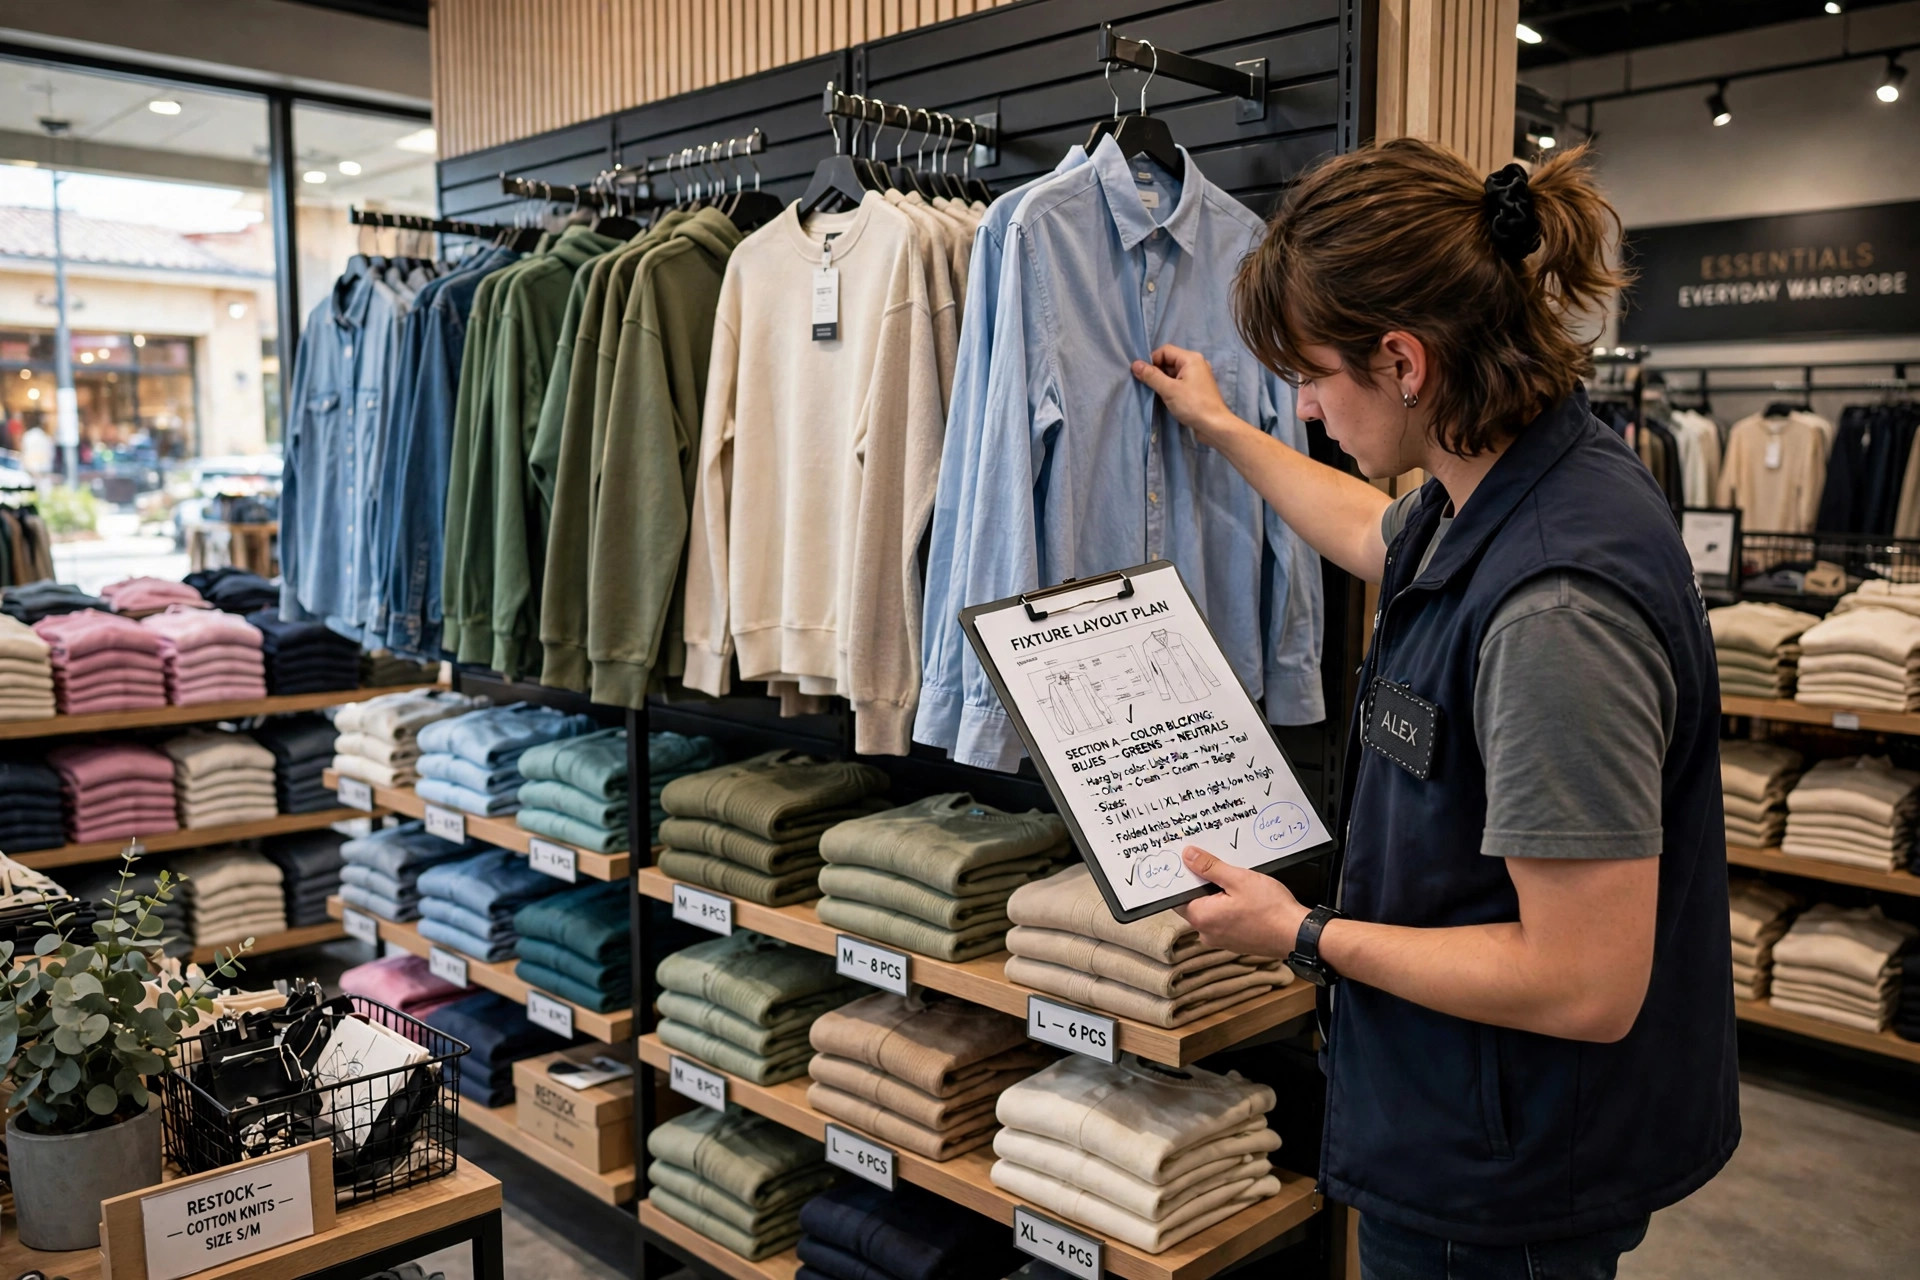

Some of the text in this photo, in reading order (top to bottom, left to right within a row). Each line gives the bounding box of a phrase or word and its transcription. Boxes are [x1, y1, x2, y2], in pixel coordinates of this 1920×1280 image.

[1701, 242, 1875, 280] ESSENTIALS
[1678, 271, 1908, 308] EVERYDAY WARDROBE
[1010, 600, 1170, 651] FIXTURE LAYOUT PLAN
[1065, 740, 1110, 760] SECTION
[1112, 738, 1121, 748] A
[1130, 724, 1166, 741] COLOR
[1121, 739, 1163, 758] GREENS
[1177, 720, 1229, 743] NEUTRALS
[1381, 710, 1418, 747] ALEX
[1110, 770, 1122, 781] by
[1229, 732, 1249, 744] Teal
[1105, 815, 1114, 826] S
[1121, 809, 1132, 821] M
[1195, 788, 1206, 797] to
[1244, 773, 1255, 782] to
[1115, 825, 1149, 844] Folded
[1200, 808, 1213, 817] on
[1122, 842, 1149, 859] group
[1149, 837, 1162, 849] by
[678, 894, 688, 911] M
[709, 905, 726, 923] PCS
[843, 947, 854, 966] M
[870, 957, 878, 973] 8
[880, 961, 902, 980] PCS
[1037, 1010, 1046, 1029] L
[1068, 1022, 1077, 1038] 6
[1081, 1024, 1107, 1047] PCS
[832, 1136, 840, 1154] L
[857, 1150, 865, 1165] 6
[867, 1153, 888, 1175] PCS
[186, 1199, 275, 1236] COTTON KNITS
[187, 1183, 255, 1217] RESTOCK
[205, 1222, 261, 1251] SIZE S/M
[1020, 1221, 1039, 1244] XL
[1056, 1240, 1065, 1256] 4
[1068, 1243, 1093, 1268] PCS
